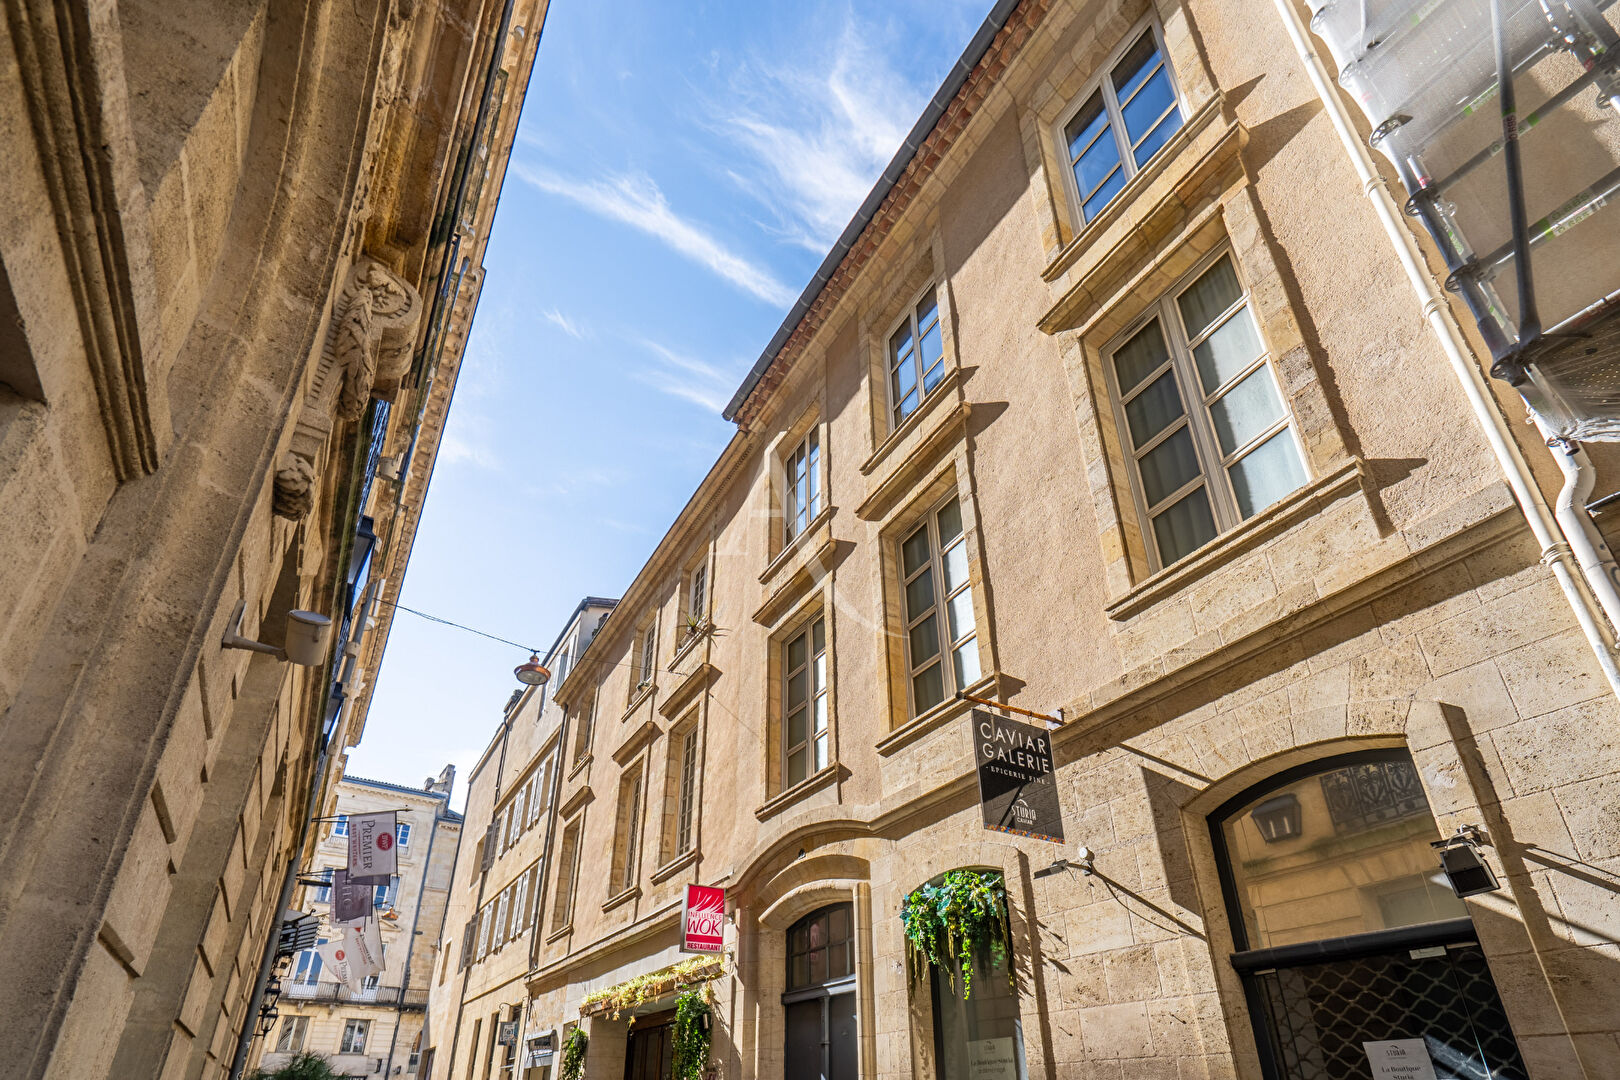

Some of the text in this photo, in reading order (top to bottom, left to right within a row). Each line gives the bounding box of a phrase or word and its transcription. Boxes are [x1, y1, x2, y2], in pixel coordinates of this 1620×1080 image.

[980, 722, 1047, 755] CAVIAR
[982, 743, 1050, 774] GALERIE
[990, 765, 1046, 785] EPICERIE FINE
[1011, 804, 1037, 821] STURIA
[361, 819, 375, 870] PREMIER
[687, 911, 723, 921] INFLUENCE
[687, 917, 722, 936] WOK
[687, 943, 721, 951] RESTAURANT
[1391, 1065, 1421, 1073] Boutique
